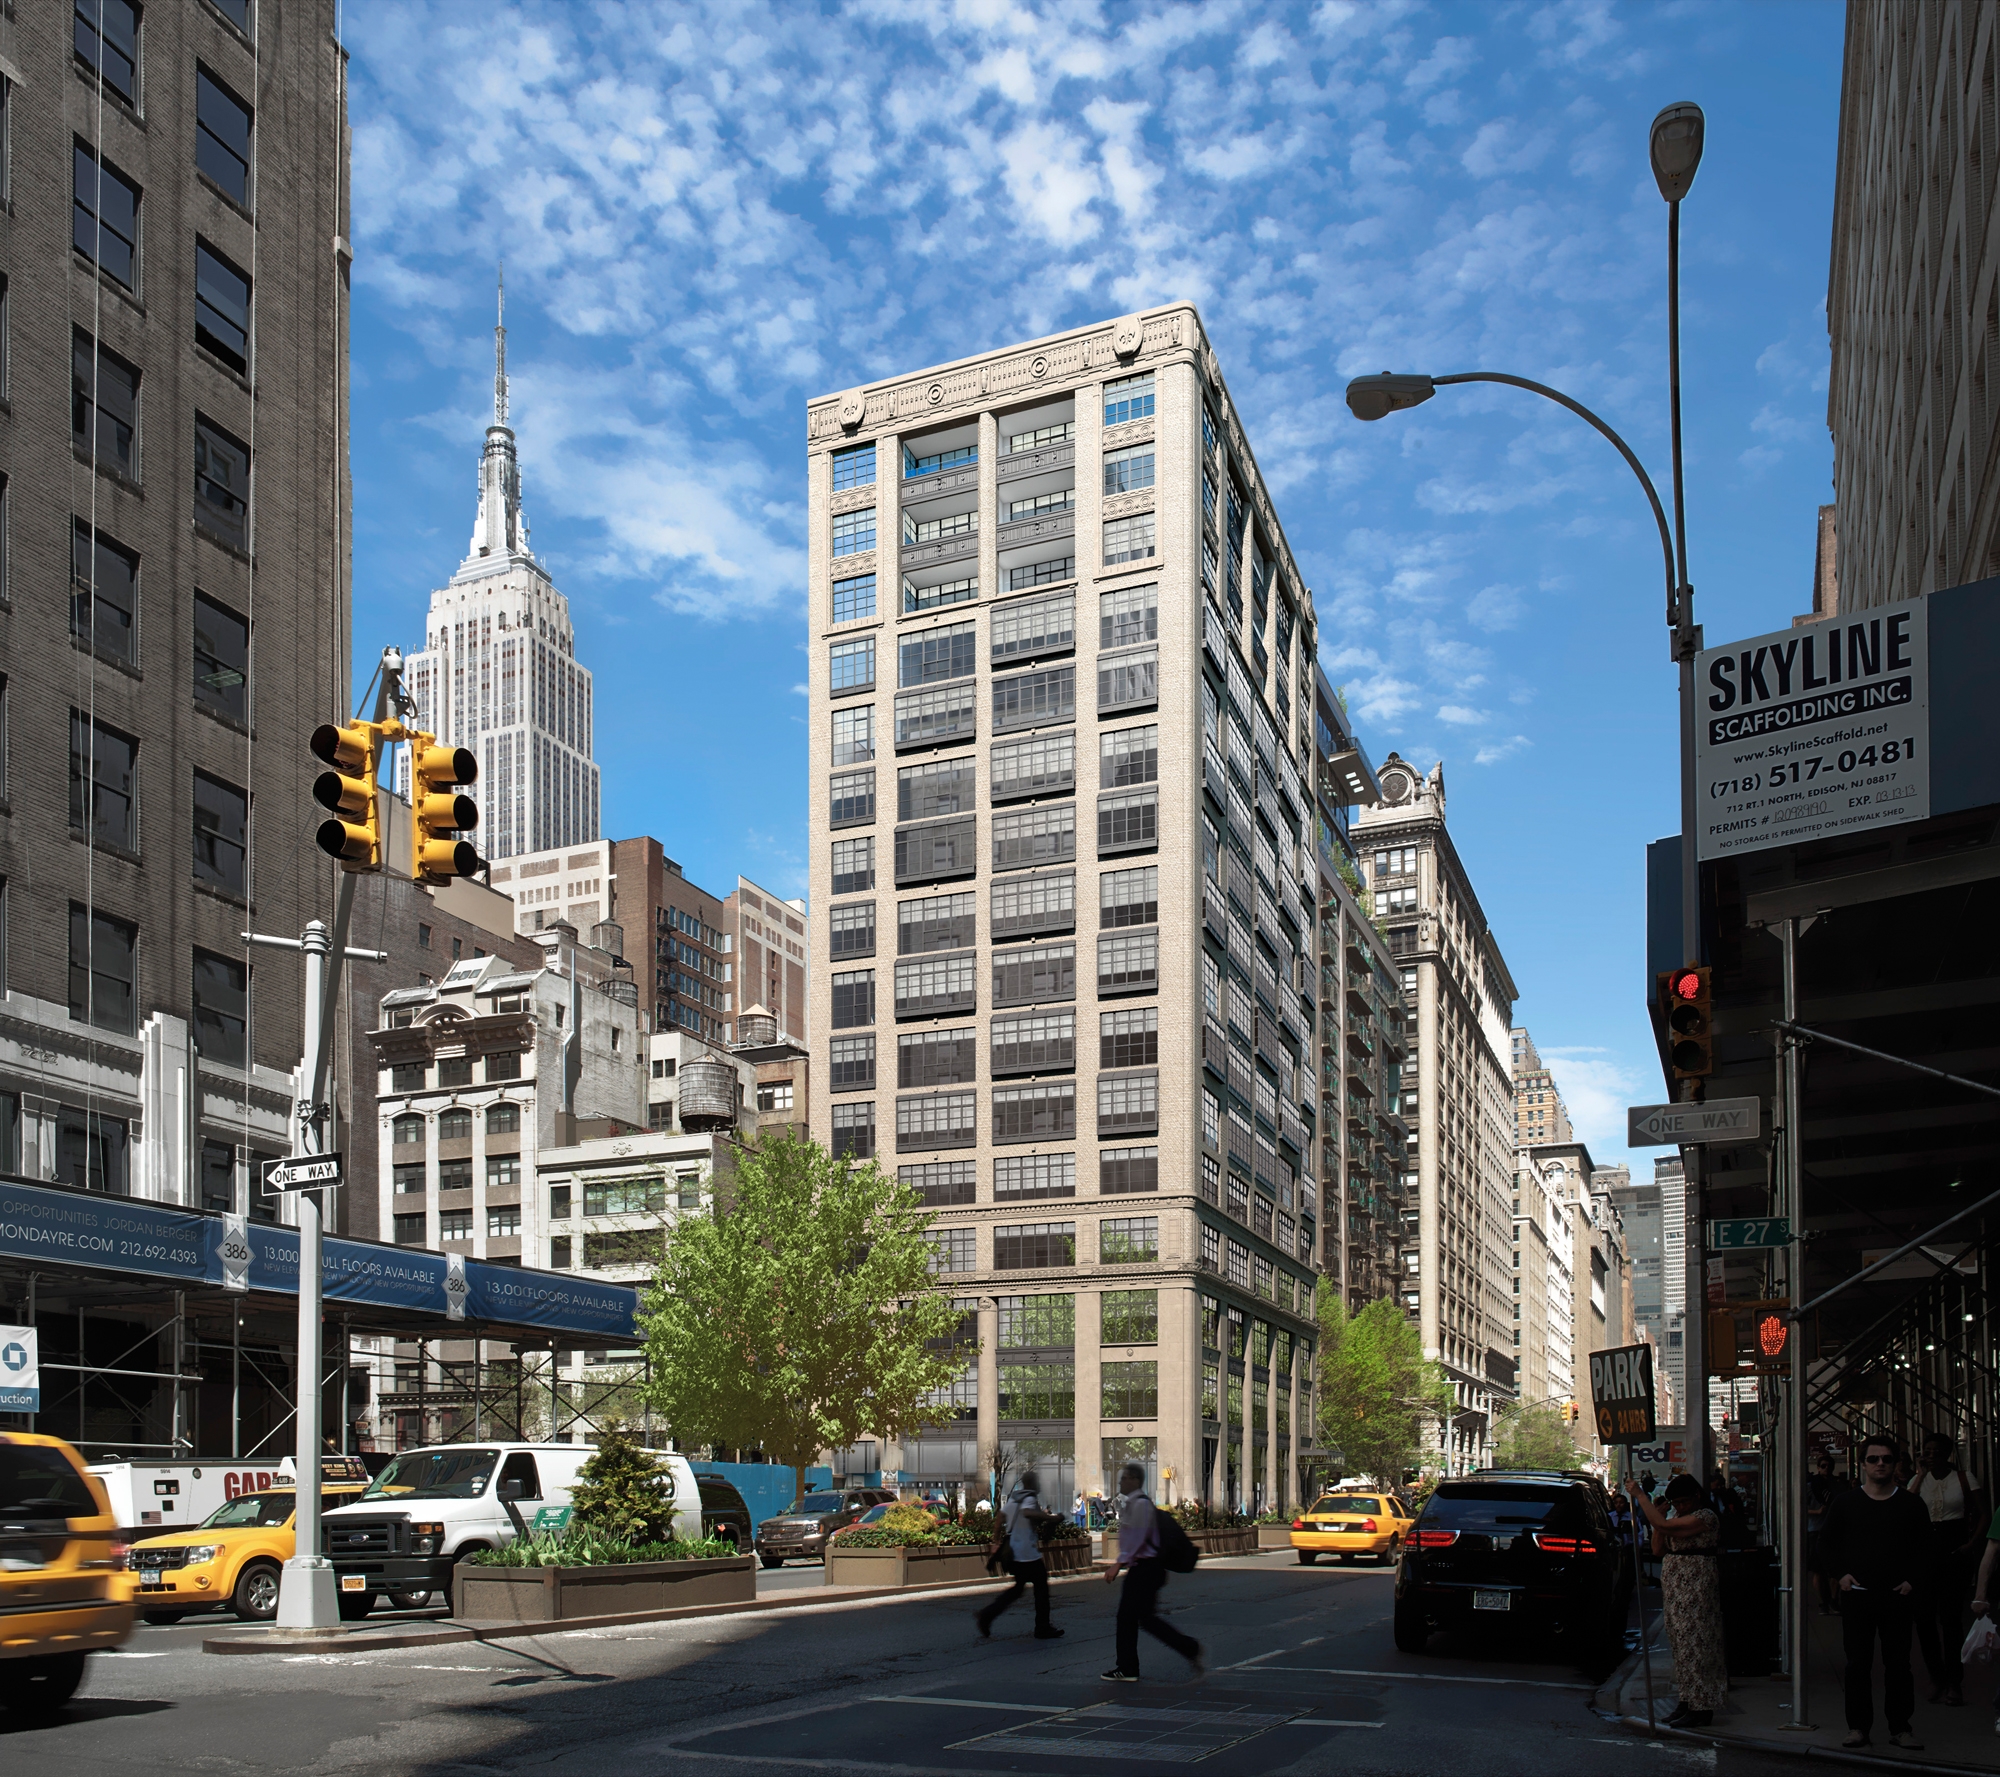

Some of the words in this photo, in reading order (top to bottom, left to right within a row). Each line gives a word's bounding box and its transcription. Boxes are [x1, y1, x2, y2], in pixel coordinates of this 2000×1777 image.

[1708, 611, 1913, 712] SKYLINE
[1714, 692, 1856, 741] SCAFFOLDING
[1863, 681, 1908, 708] INC.
[1733, 722, 1889, 764] www.SkylineScaffold.net
[1710, 773, 1761, 799] (718)
[1768, 737, 1915, 788] 517-0481
[1726, 804, 1743, 814] 712
[1746, 799, 1764, 810] RT.1
[1768, 792, 1805, 806] NORTH,
[1807, 783, 1848, 798] EDISON,
[1851, 780, 1863, 789] NJ
[1866, 773, 1897, 786] 08817
[1709, 817, 1757, 835] PERMITS
[1848, 795, 1872, 808] EXP.
[1719, 840, 1733, 849] NO
[1734, 833, 1769, 846] STORAGE
[1781, 824, 1822, 837] PERMITTED
[1824, 820, 1838, 829] ON
[1840, 812, 1881, 826] SIDEWALK
[1882, 807, 1905, 818] SHED
[1648, 1115, 1684, 1134] ONE
[1702, 1110, 1741, 1129] WAY
[274, 1168, 298, 1184] ONE
[307, 1163, 334, 1179] WAY
[3, 1200, 98, 1227] OPPORTUNITIES
[104, 1217, 153, 1236] JORDAN
[156, 1225, 198, 1243] BERGER
[1719, 1224, 1732, 1246] E
[1742, 1221, 1770, 1245] 27
[120, 1241, 198, 1265] 212.692.4393
[224, 1242, 248, 1260] 386
[263, 1263, 280, 1273] NEW
[264, 1246, 299, 1264] 13,000
[321, 1255, 340, 1270] ULL
[342, 1258, 382, 1276] FLOORS
[384, 1265, 435, 1285] AVAILABLE
[448, 1277, 465, 1294] 386
[572, 1294, 624, 1313] AVAILABLE
[1591, 1349, 1647, 1403] PARK
[1617, 1409, 1629, 1434] 24
[1629, 1408, 1647, 1433] HRS
